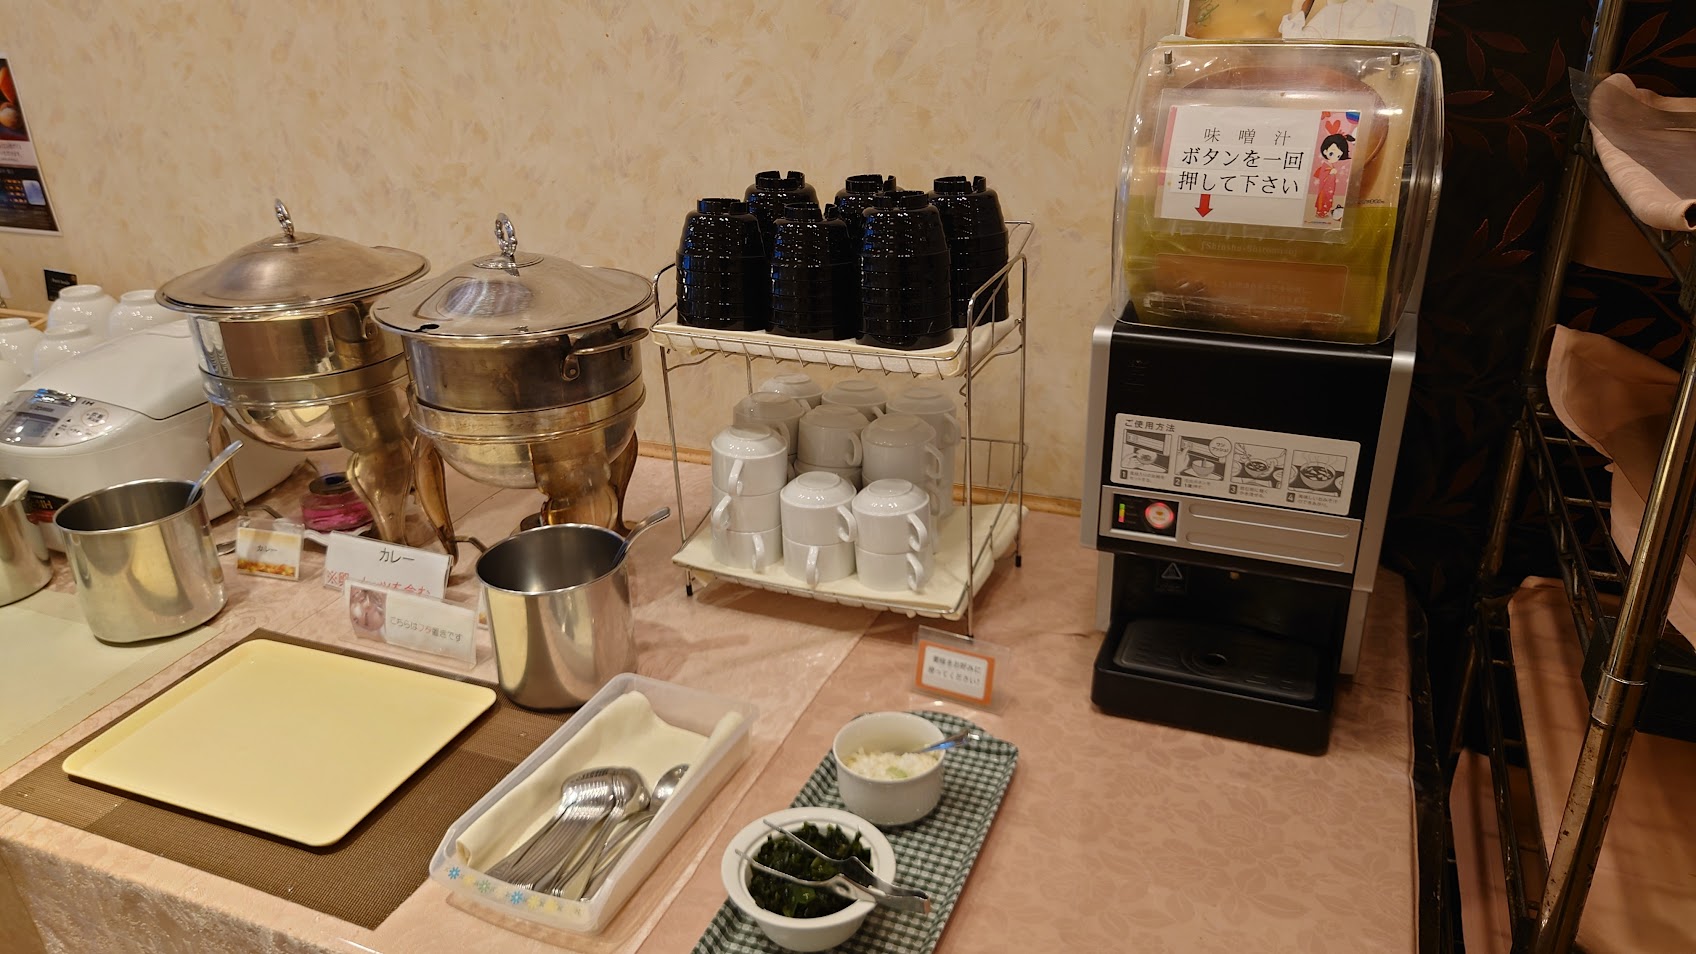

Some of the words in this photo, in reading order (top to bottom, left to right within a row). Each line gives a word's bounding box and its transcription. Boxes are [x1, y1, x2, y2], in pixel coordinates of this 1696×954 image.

[1203, 126, 1291, 147] 味噌汁
[1182, 147, 1304, 171] ボタンを一回
[1178, 171, 1299, 195] 押して下さい
[1124, 418, 1176, 432] ご使用方法
[379, 547, 415, 564] カレー
